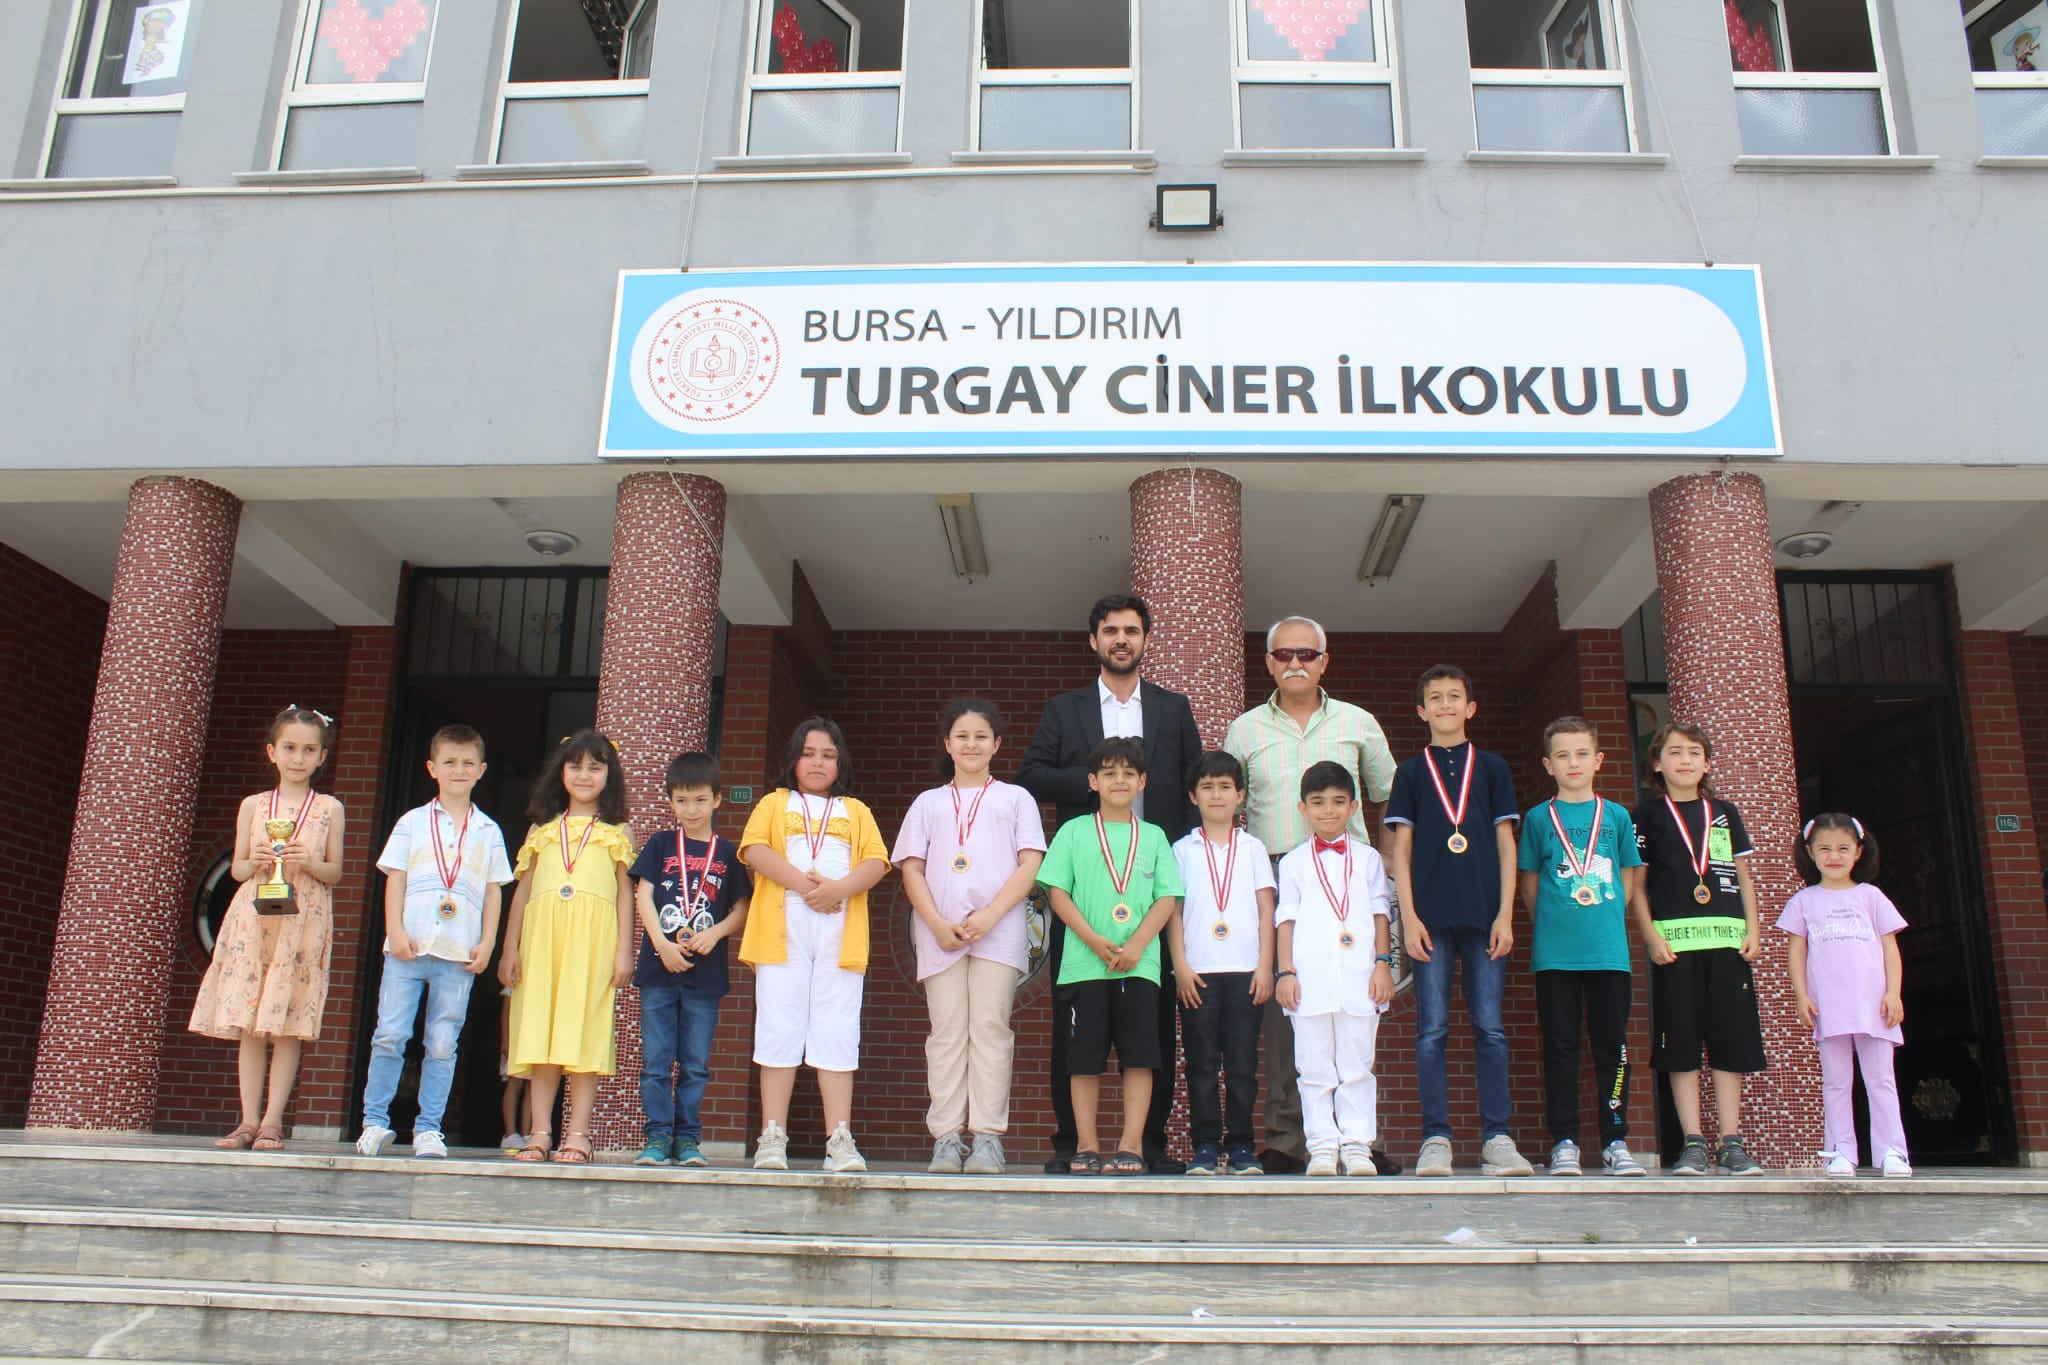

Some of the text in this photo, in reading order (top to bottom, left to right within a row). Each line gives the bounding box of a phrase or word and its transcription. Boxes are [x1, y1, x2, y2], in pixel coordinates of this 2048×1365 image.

[803, 309, 948, 342] BURSA
[987, 307, 1182, 340] YILDIRIM
[800, 353, 1689, 417] TURGAY CİNER İLKOKULU
